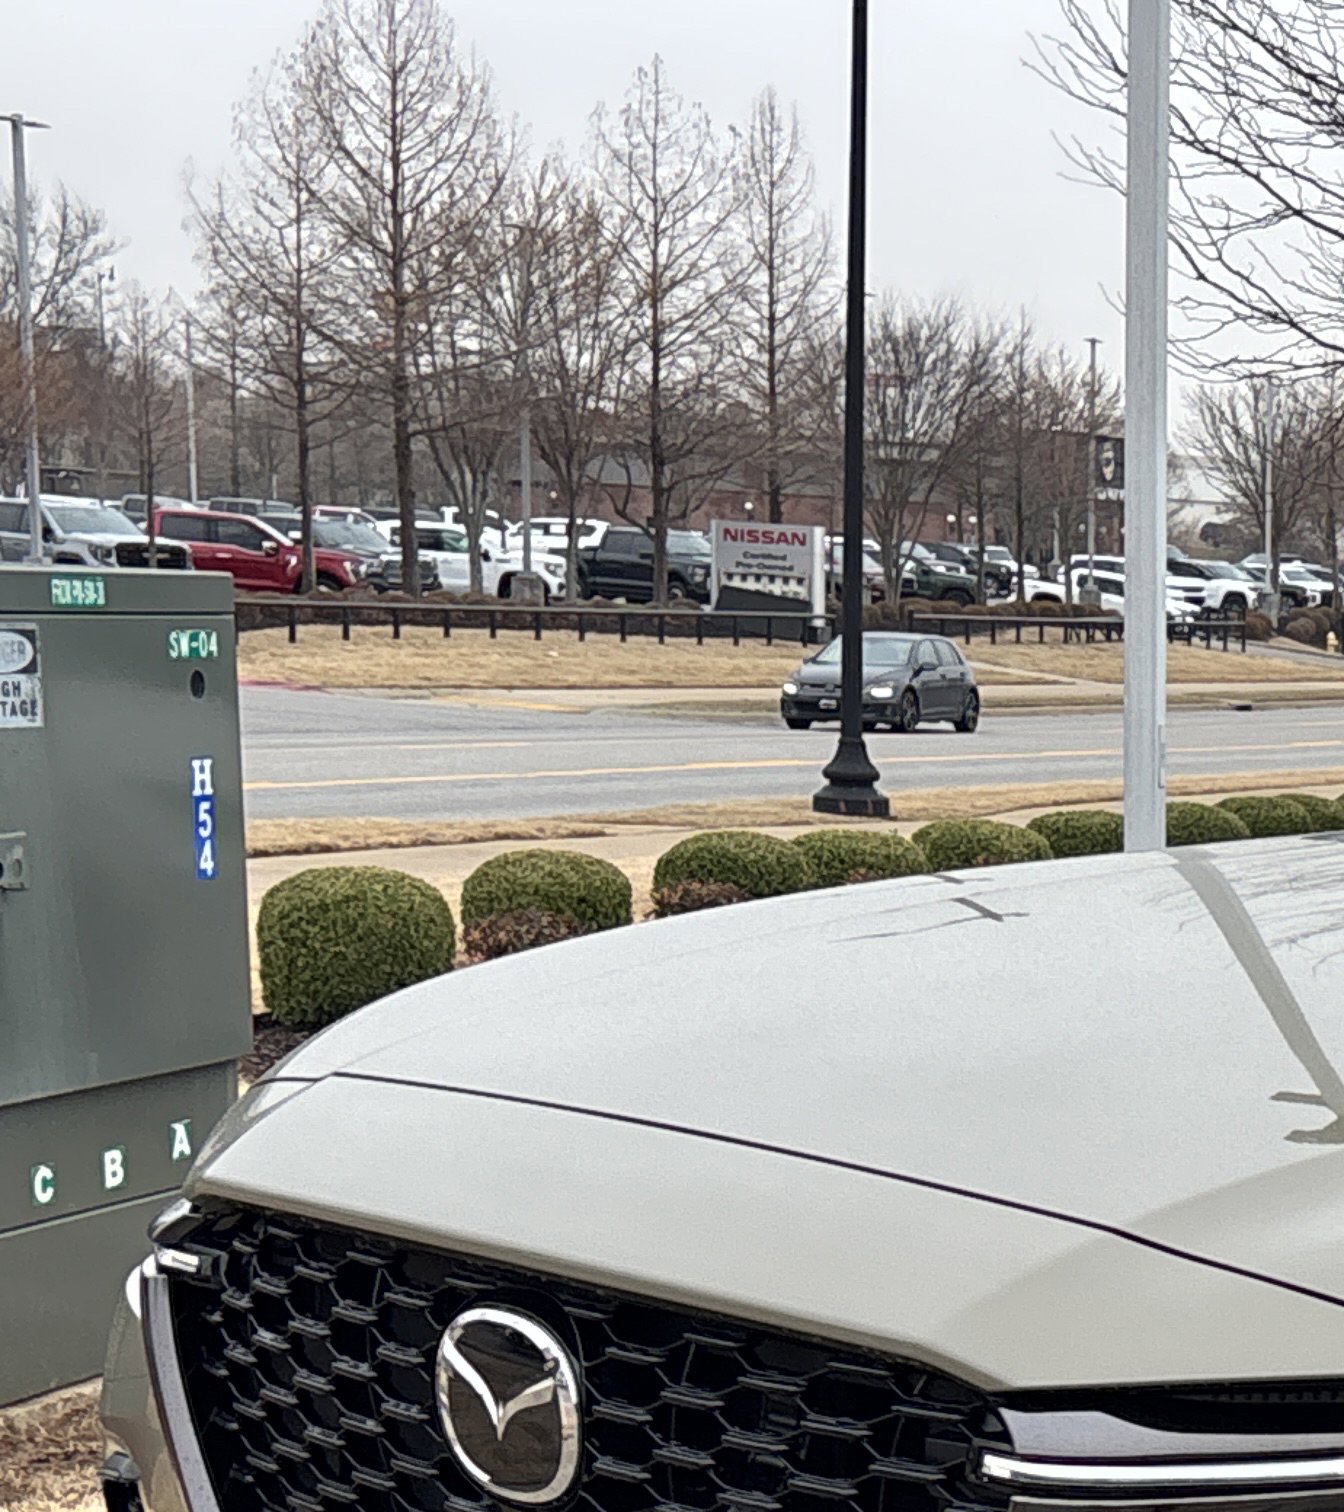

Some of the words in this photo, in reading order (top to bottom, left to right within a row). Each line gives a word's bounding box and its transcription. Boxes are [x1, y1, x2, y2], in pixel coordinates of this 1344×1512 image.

[723, 527, 808, 546] NISSAN
[168, 630, 219, 659] SW-04
[33, 1165, 55, 1203] C
[104, 1149, 125, 1189] B
[171, 1120, 192, 1160] A
